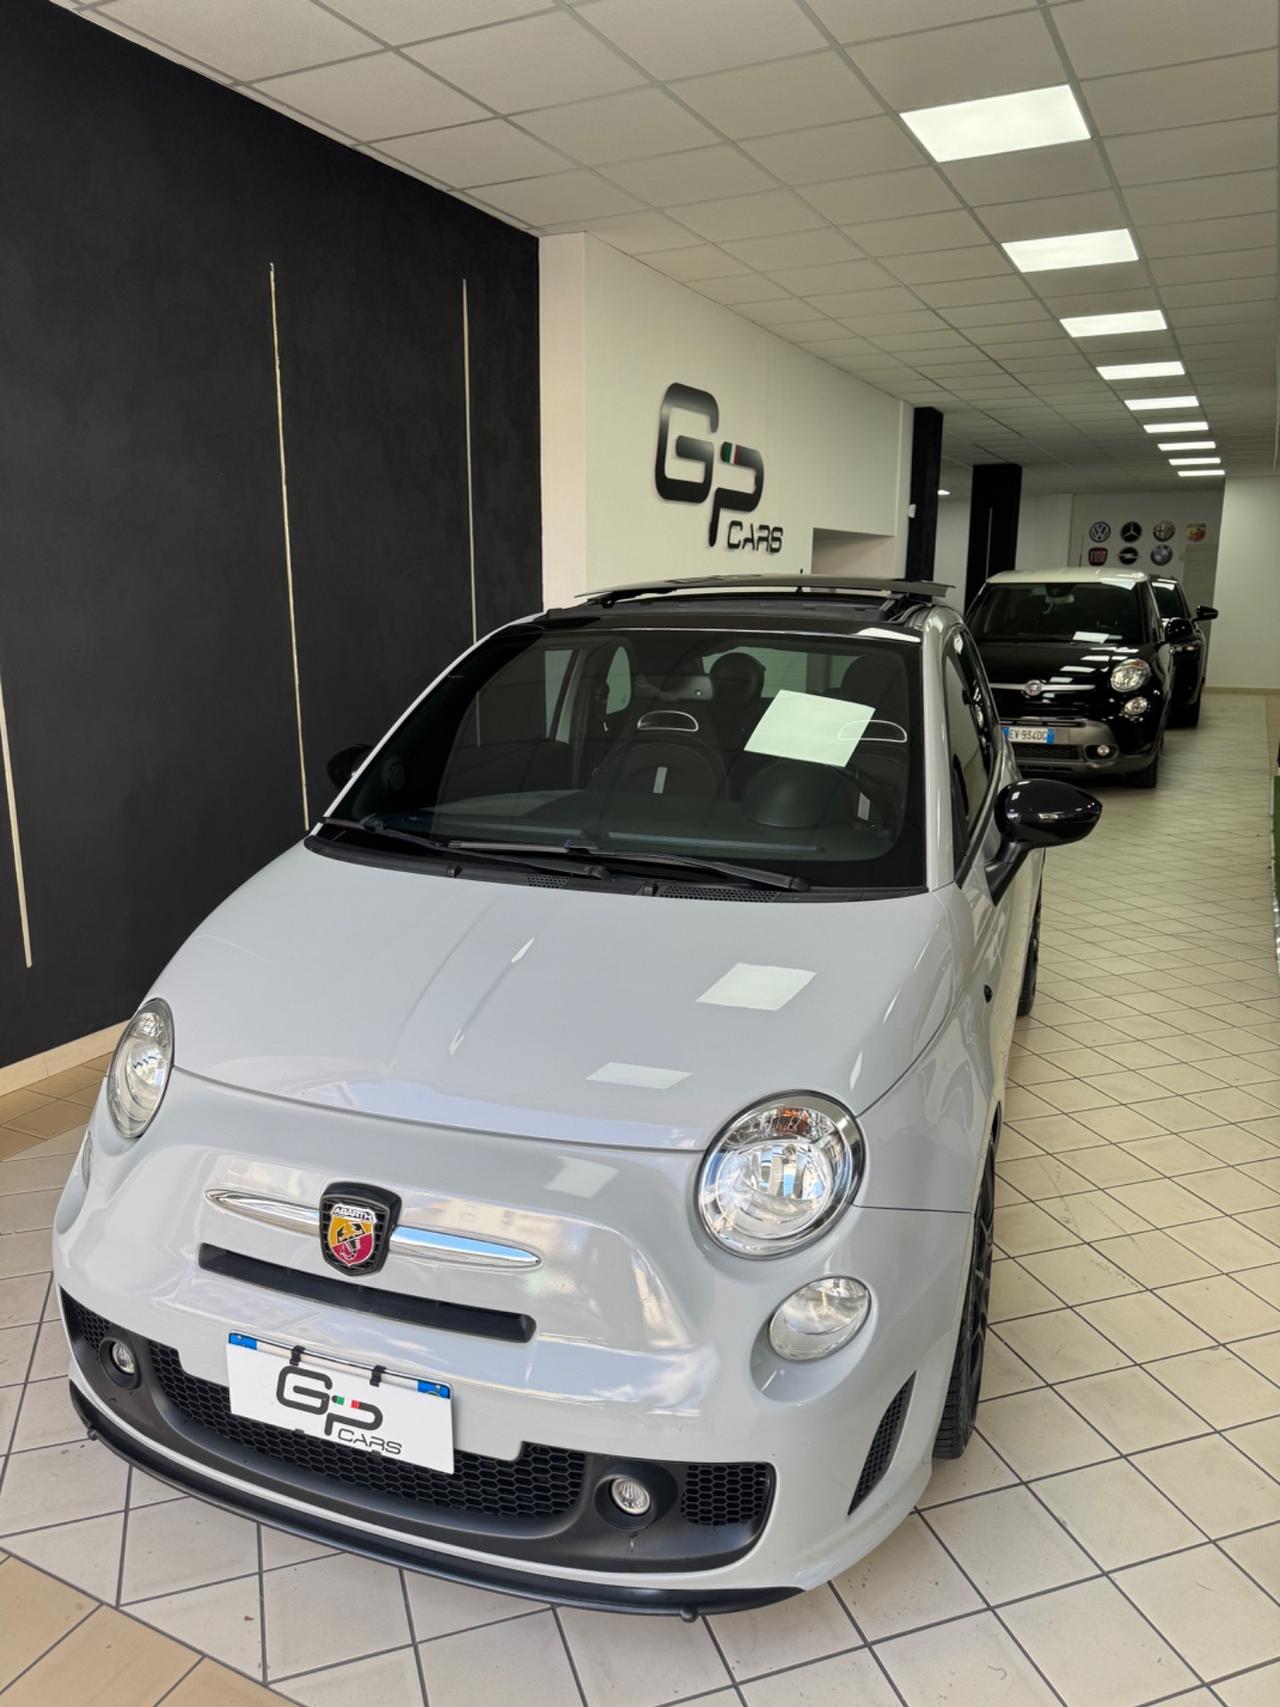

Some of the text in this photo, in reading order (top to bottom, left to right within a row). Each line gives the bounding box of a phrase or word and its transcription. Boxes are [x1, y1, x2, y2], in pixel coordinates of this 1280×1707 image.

[727, 520, 784, 553] CARS
[334, 1206, 372, 1221] ABARTH
[276, 1365, 383, 1436] GP
[337, 1428, 402, 1455] CARS
